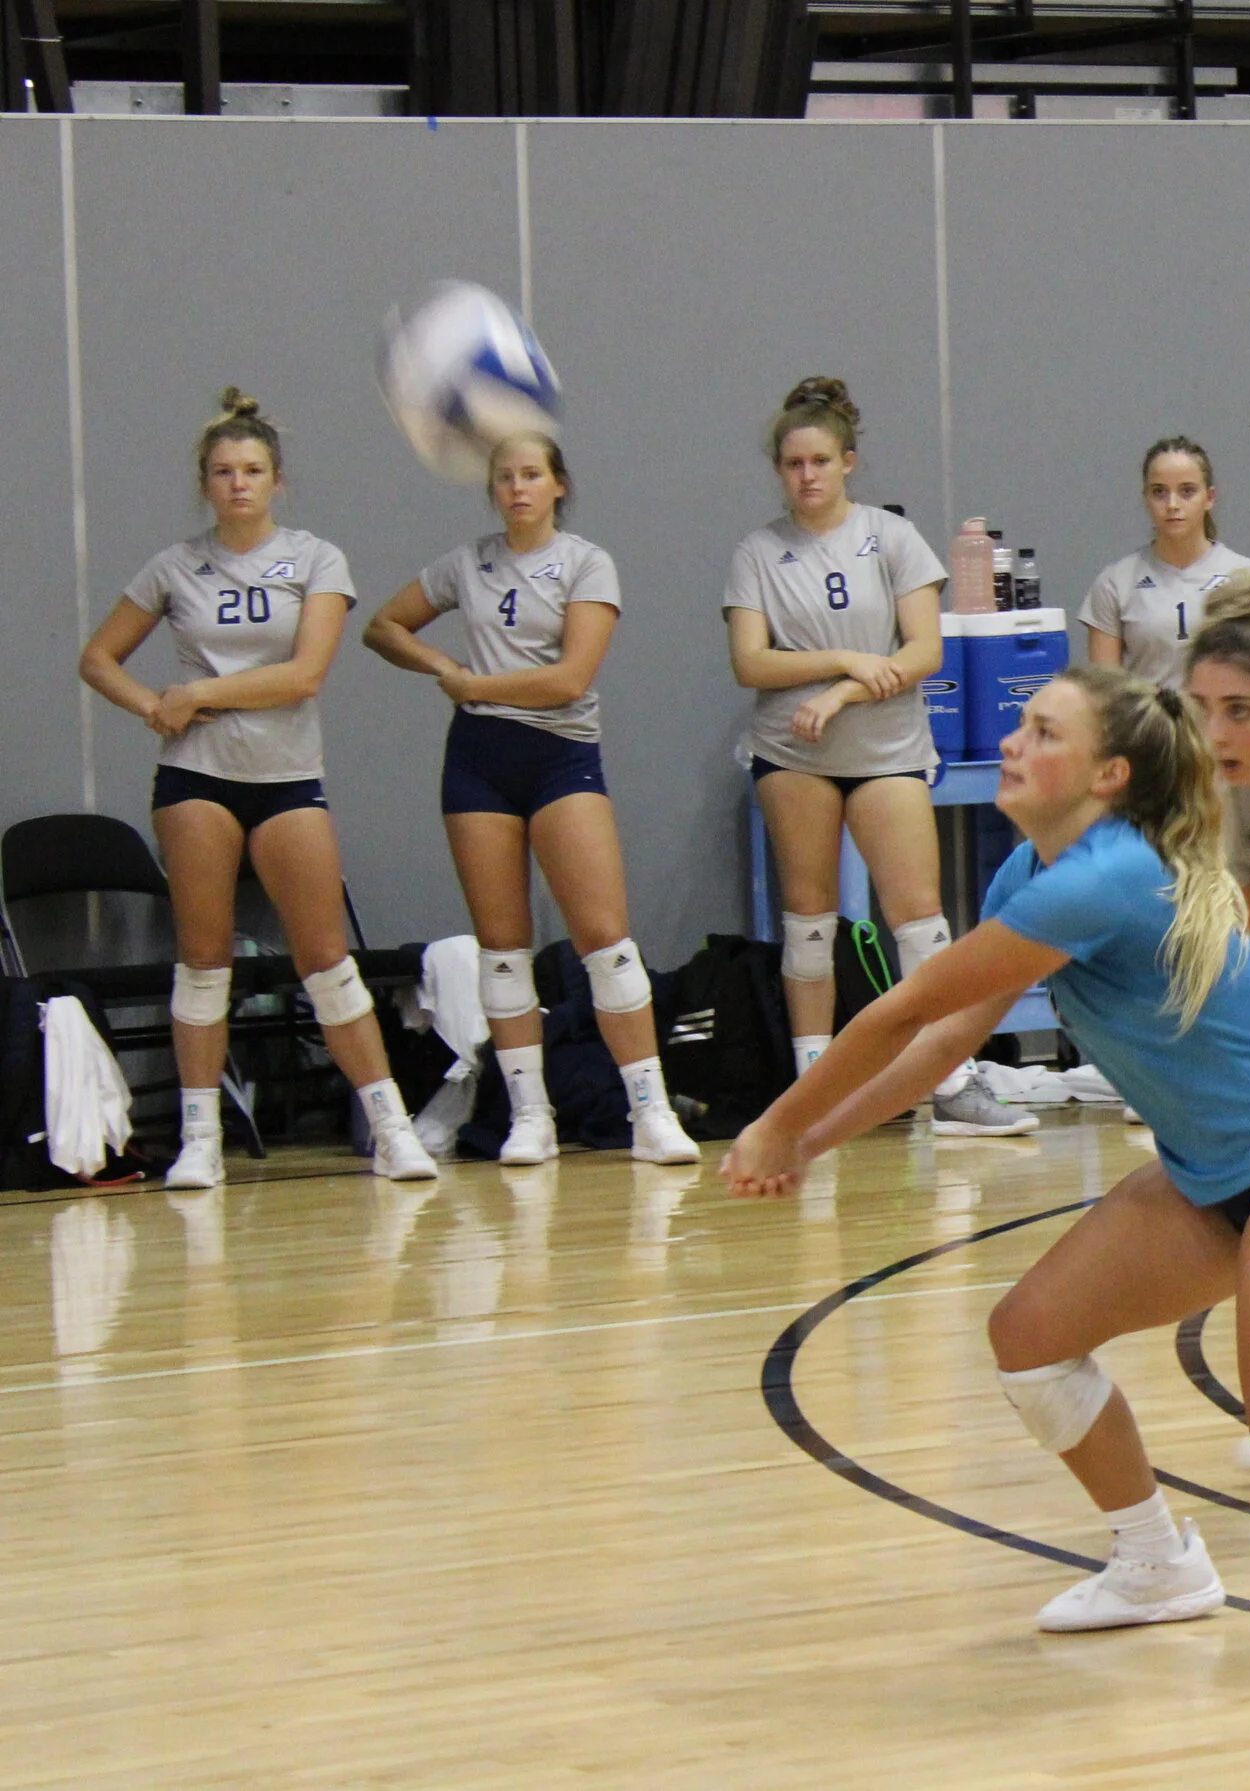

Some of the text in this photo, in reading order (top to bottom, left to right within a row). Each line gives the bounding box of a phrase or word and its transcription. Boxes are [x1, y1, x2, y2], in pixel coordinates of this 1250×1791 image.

[217, 585, 271, 625] 20
[498, 588, 518, 627] 4
[825, 571, 850, 611] 8
[1175, 601, 1189, 641] 1
